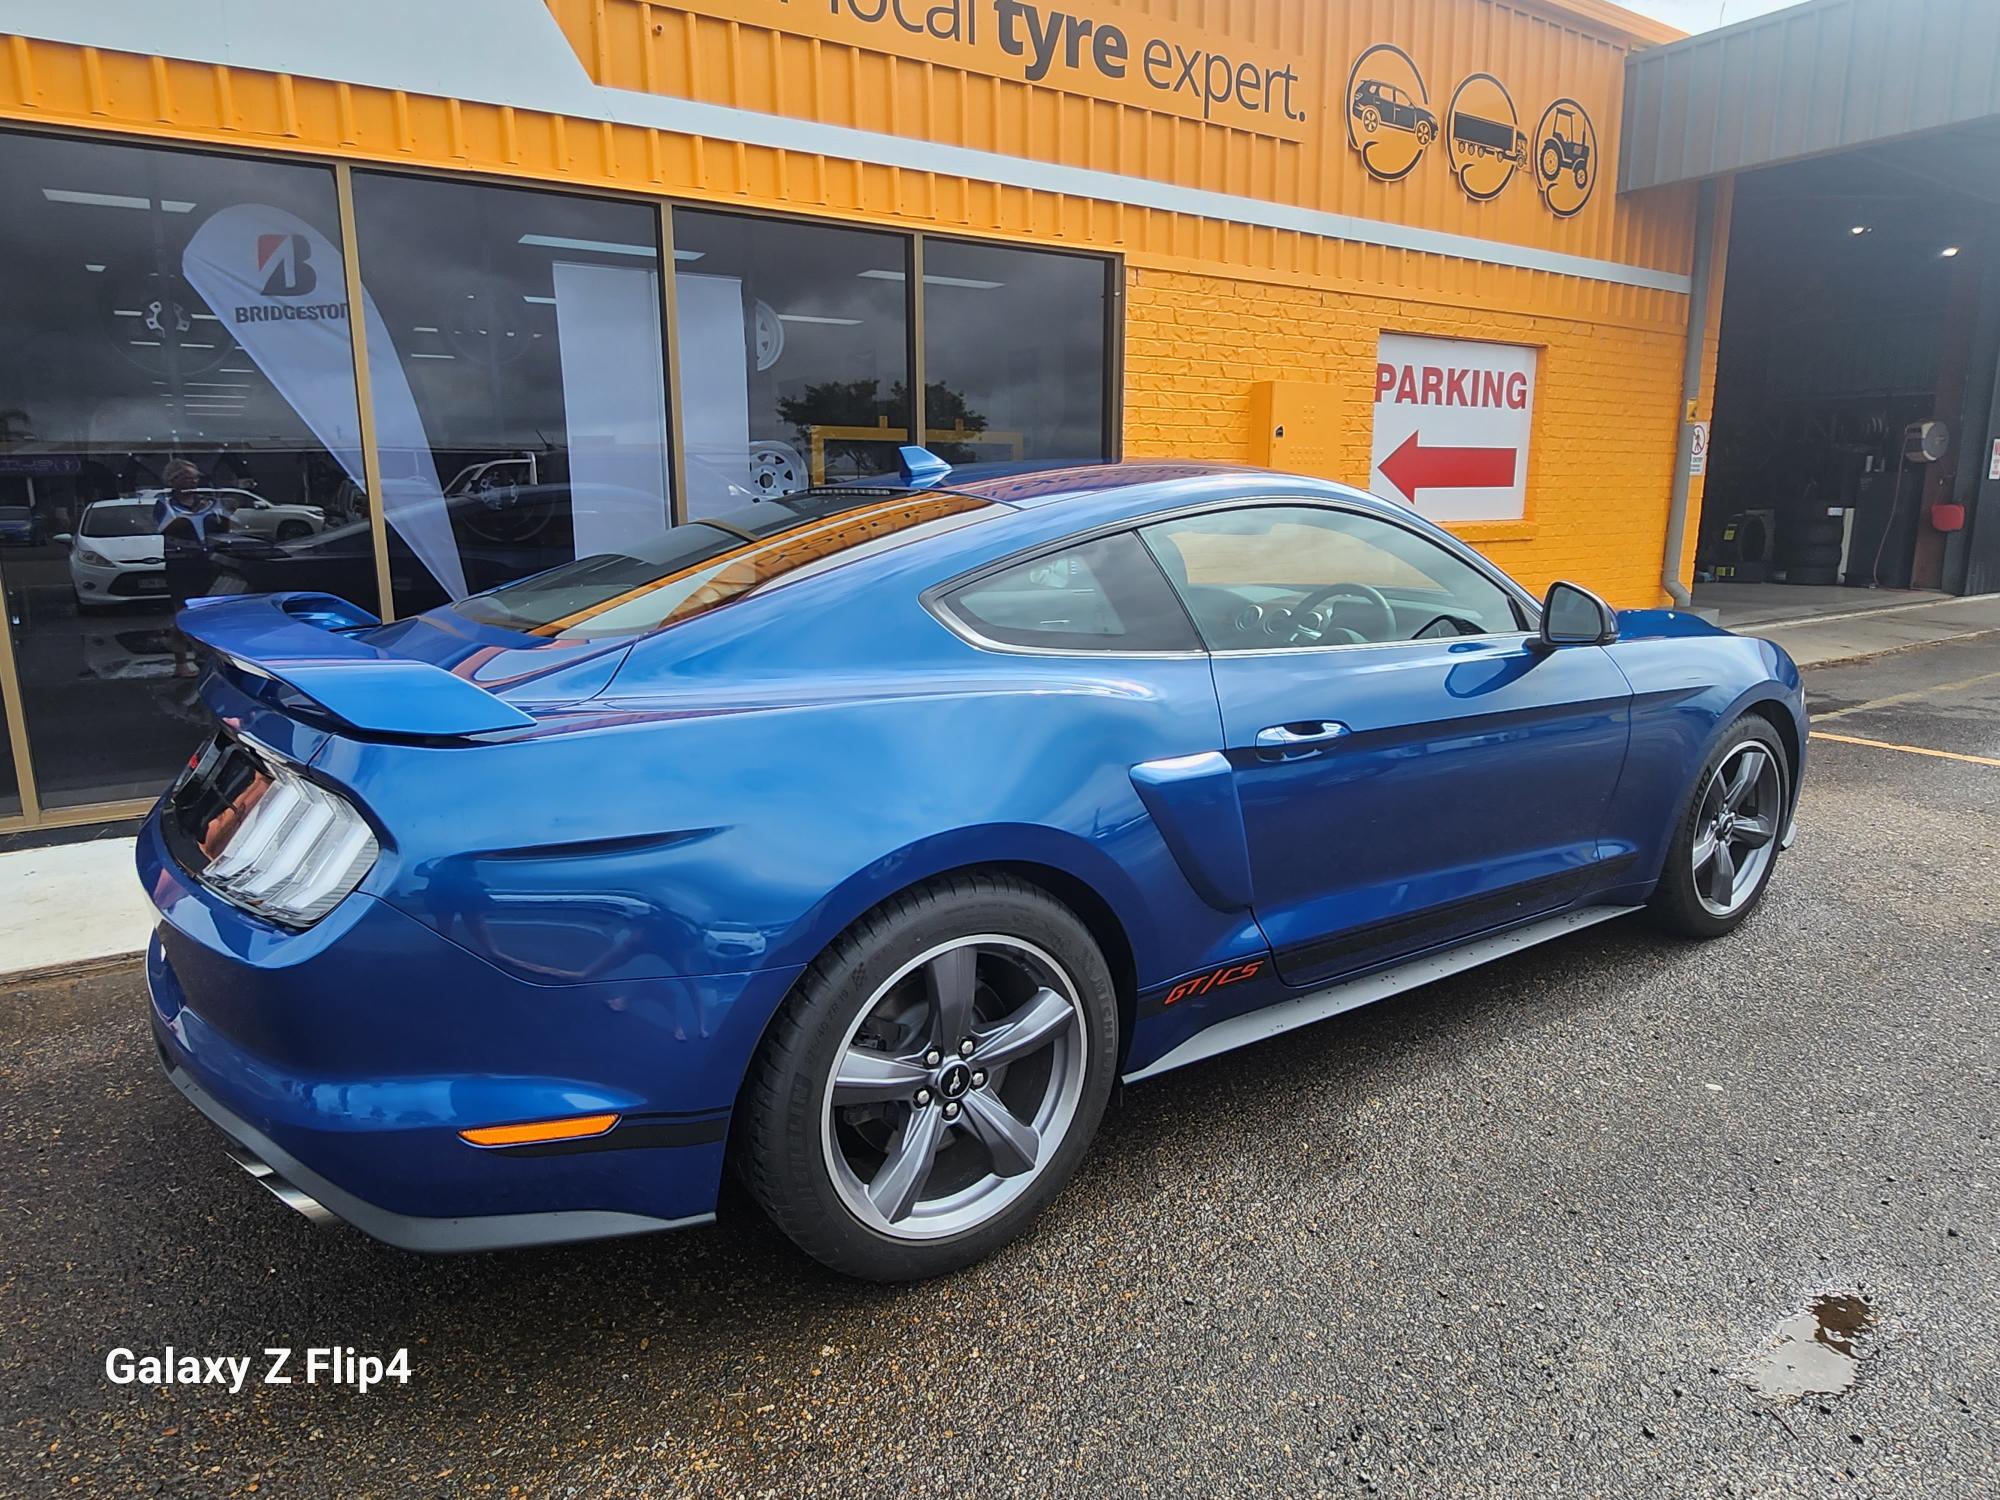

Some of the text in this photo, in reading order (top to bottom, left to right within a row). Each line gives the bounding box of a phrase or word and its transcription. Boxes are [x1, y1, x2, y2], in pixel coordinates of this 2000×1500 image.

[830, 0, 1306, 121] cal tyre expert.
[1375, 363, 1527, 409] PARKING
[1164, 960, 1264, 1005] GT/CS
